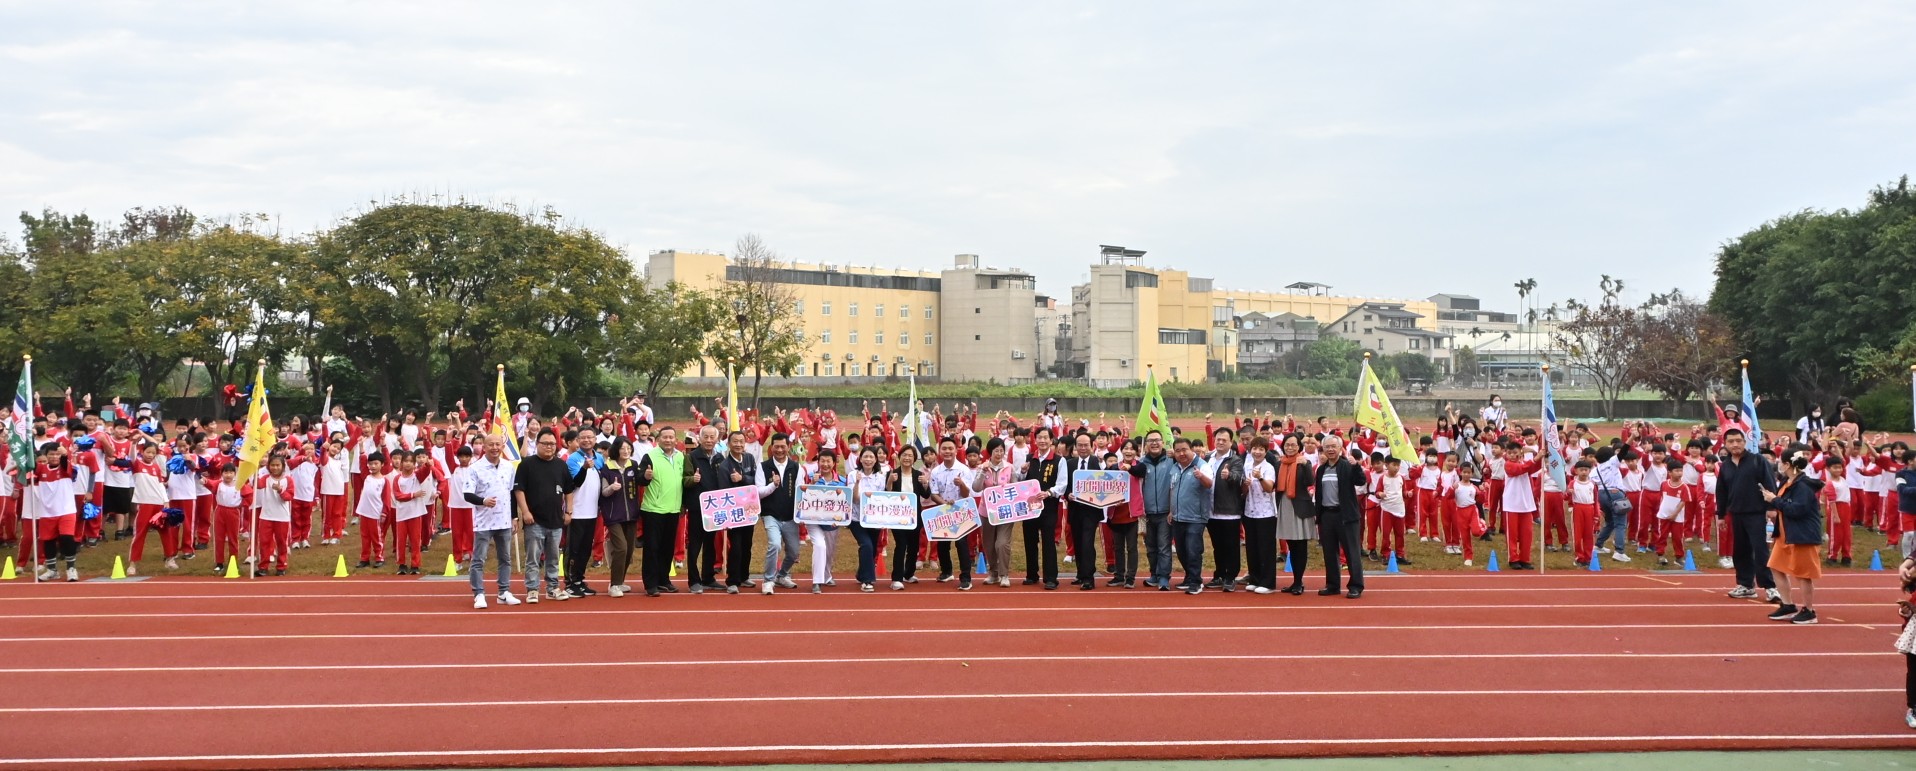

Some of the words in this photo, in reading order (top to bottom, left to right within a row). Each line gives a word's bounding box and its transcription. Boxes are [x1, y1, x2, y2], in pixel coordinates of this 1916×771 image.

[1075, 480, 1127, 494] 打開世界
[704, 493, 735, 508] 大大
[988, 487, 1018, 503] 小手
[799, 499, 849, 512] 心中發光
[865, 504, 913, 517] 書中漫遊
[997, 501, 1029, 520] 翻書
[713, 508, 745, 525] 夢想
[927, 508, 976, 532] 打開書本
